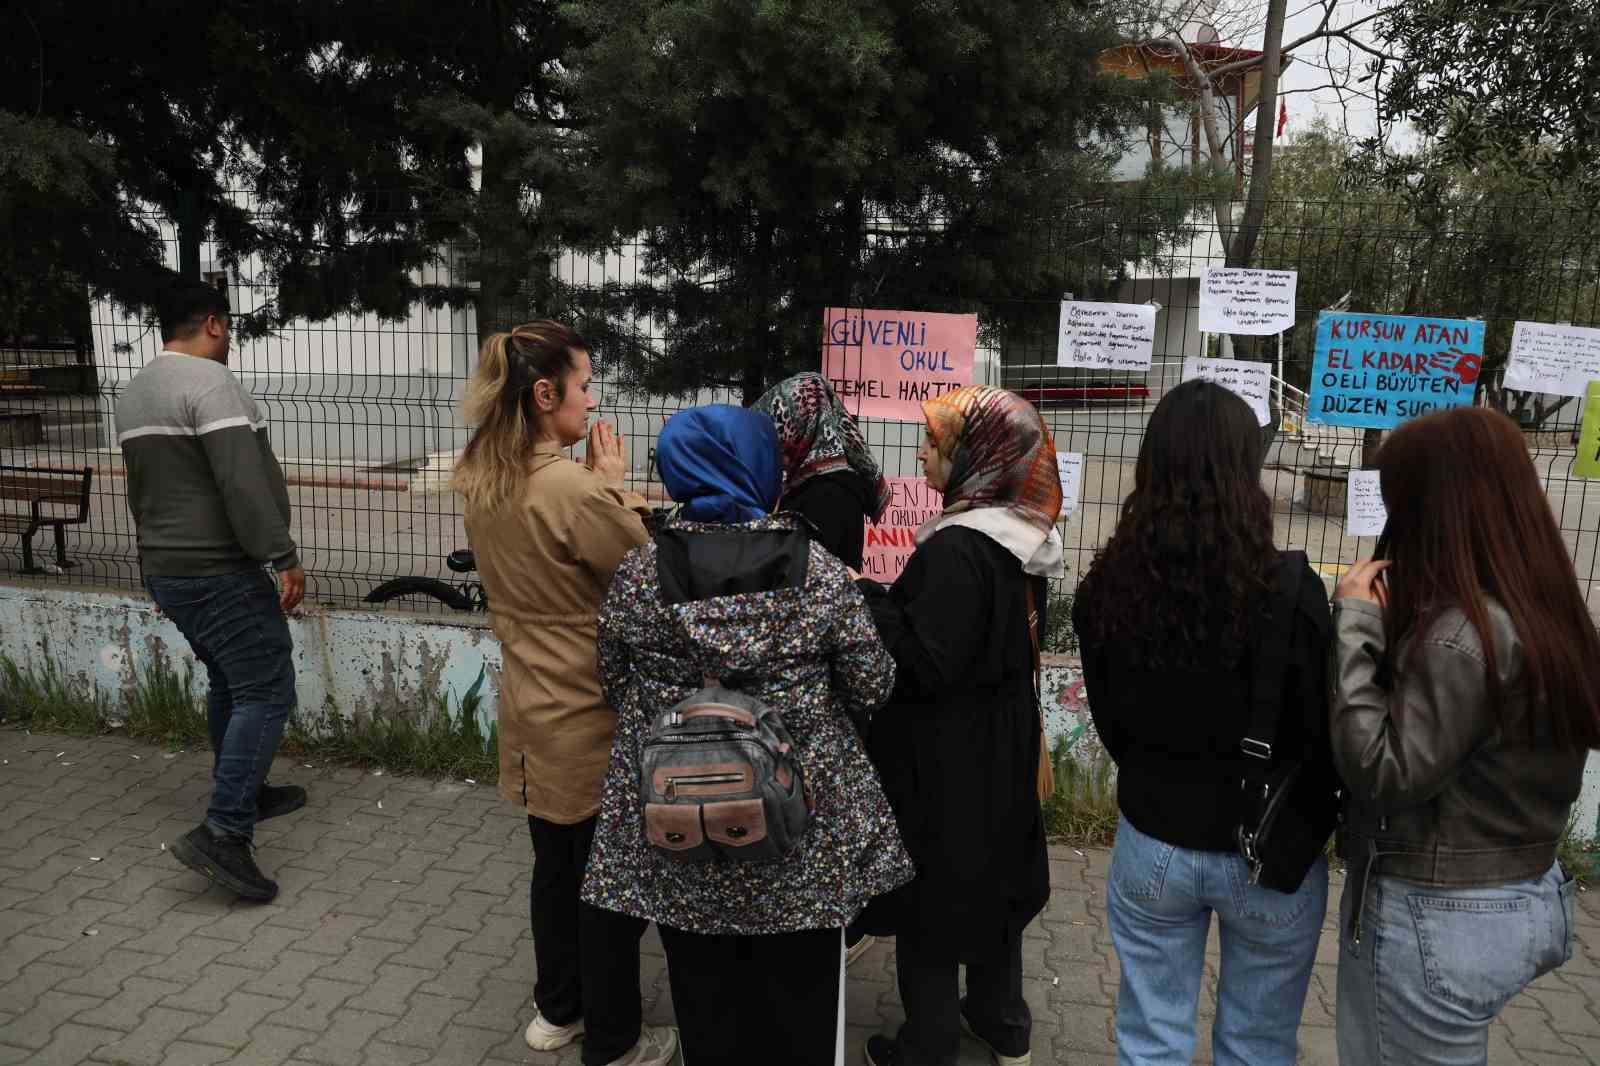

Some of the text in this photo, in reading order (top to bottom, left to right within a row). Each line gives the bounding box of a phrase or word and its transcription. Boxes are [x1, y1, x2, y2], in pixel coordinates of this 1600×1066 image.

[831, 315, 926, 346] GÜVENLİ
[1331, 319, 1469, 345] KURŞUN ATAN
[900, 350, 954, 372] OKUL
[1327, 348, 1431, 375] EL KADAR
[829, 379, 891, 398] TEMEL
[1376, 372, 1460, 395] BÜYÜTEN
[1321, 394, 1387, 417] DÜZEN
